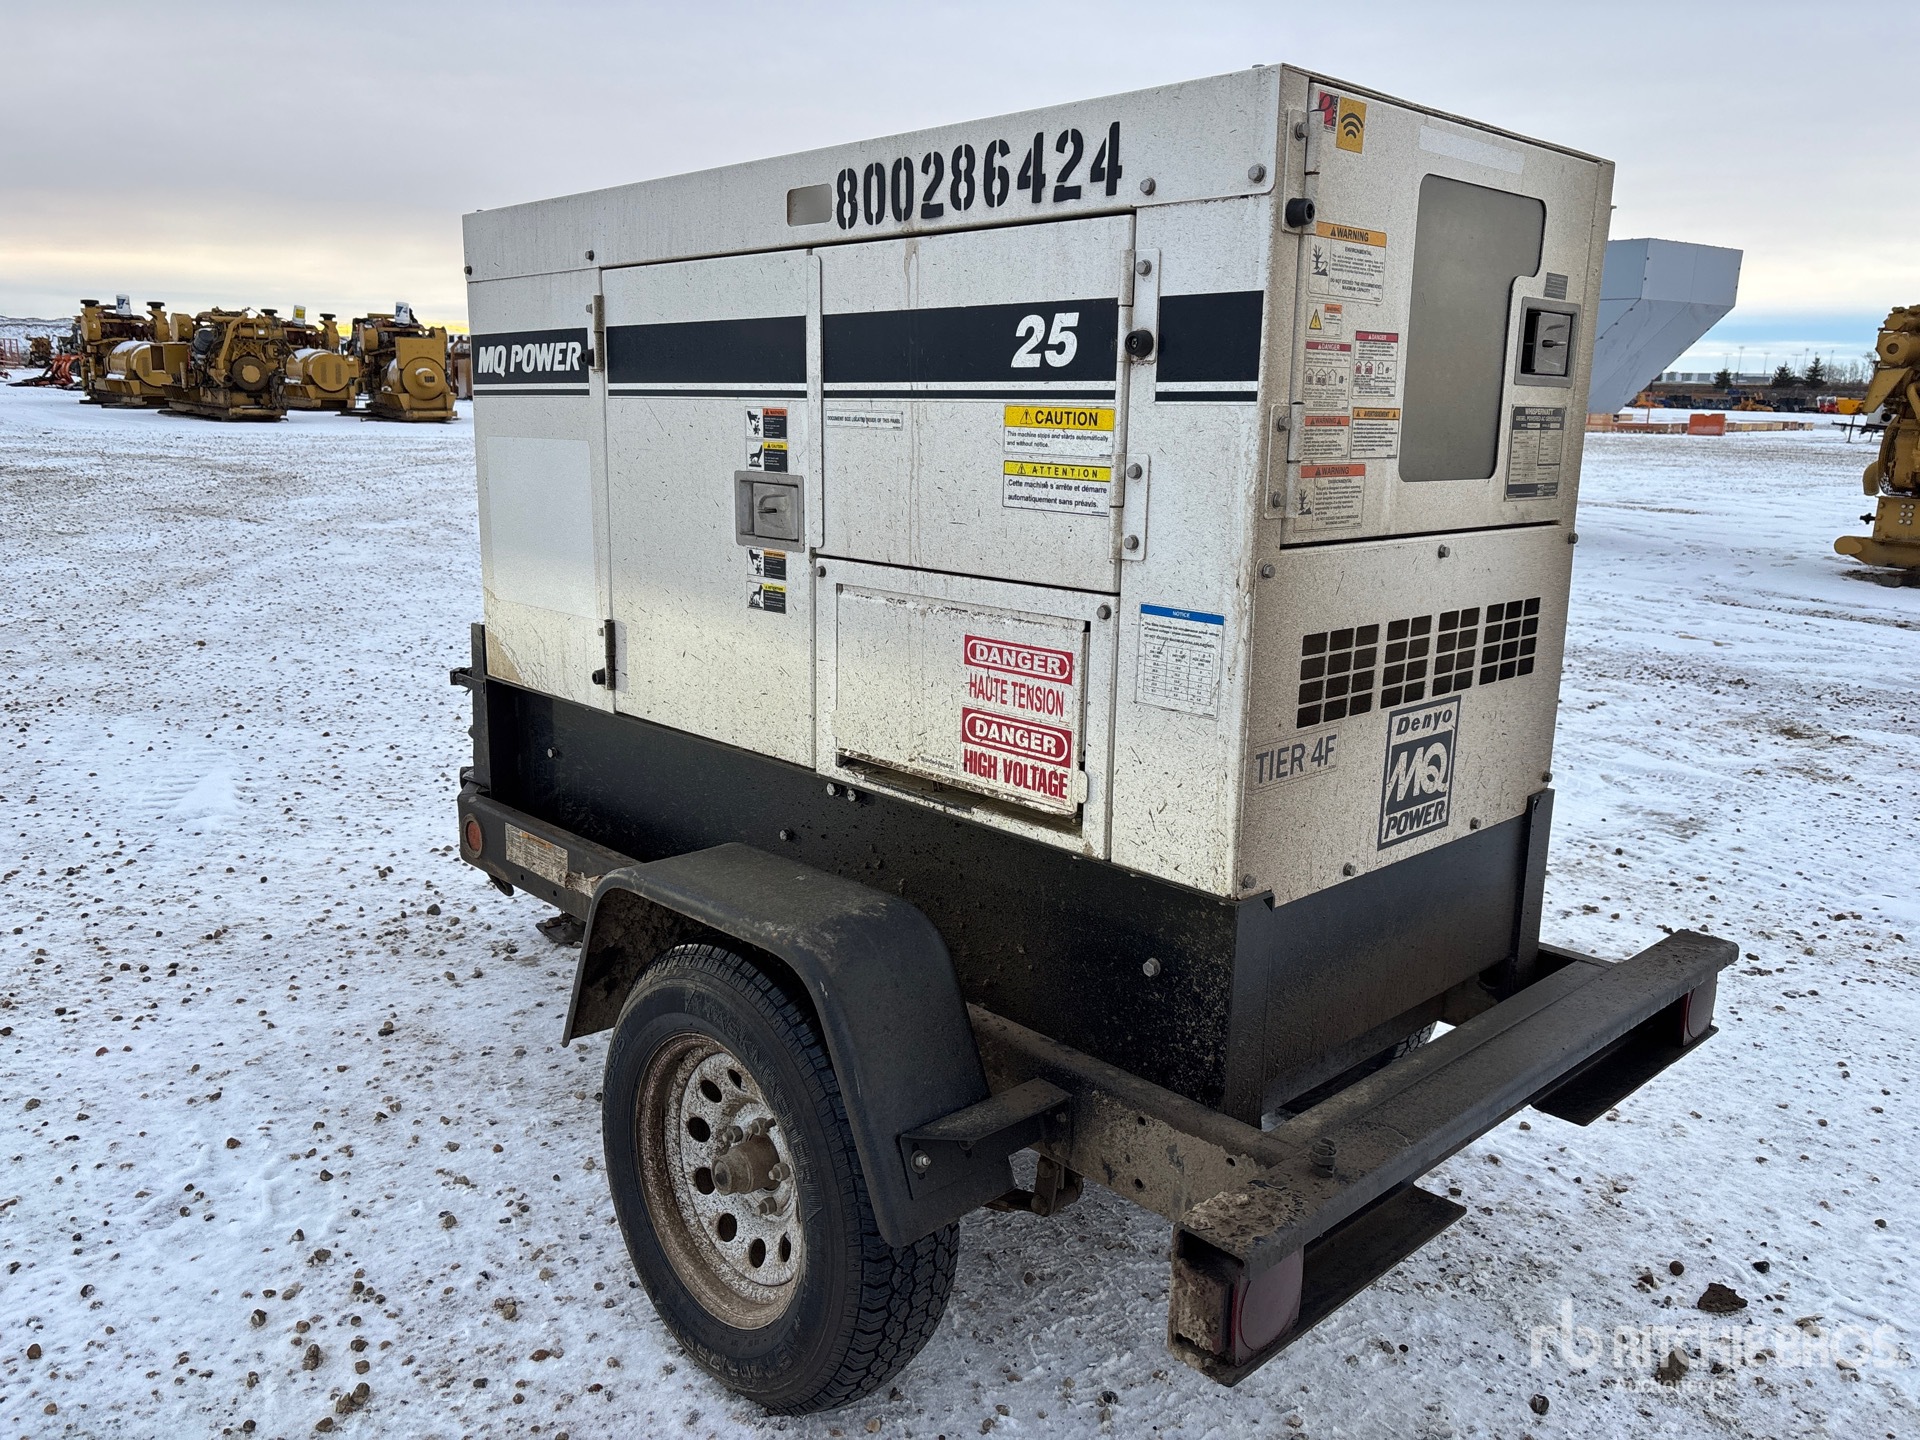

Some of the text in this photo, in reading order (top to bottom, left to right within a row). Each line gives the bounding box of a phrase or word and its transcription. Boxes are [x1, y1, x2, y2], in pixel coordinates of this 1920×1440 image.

[836, 120, 1122, 230] 800286424
[1337, 227, 1368, 242] WARNING
[1010, 312, 1079, 368] 25
[478, 342, 582, 378] MQ POWER
[1035, 410, 1098, 426] CAUTION
[1032, 466, 1098, 478] ATTENTION
[1322, 467, 1349, 475] WARNING
[1008, 494, 1057, 504] automatiquement
[1081, 485, 1107, 494] démarre
[975, 644, 1061, 675] DANGER
[969, 673, 1064, 717] HAUTE TENSION
[975, 720, 1056, 754] DANGER
[1396, 709, 1452, 736] Denyo
[964, 748, 1068, 799] HIGH VOLTAGE
[1255, 734, 1337, 784] TIER 4F
[1386, 742, 1448, 801] MQ
[1384, 800, 1445, 839] POWER
